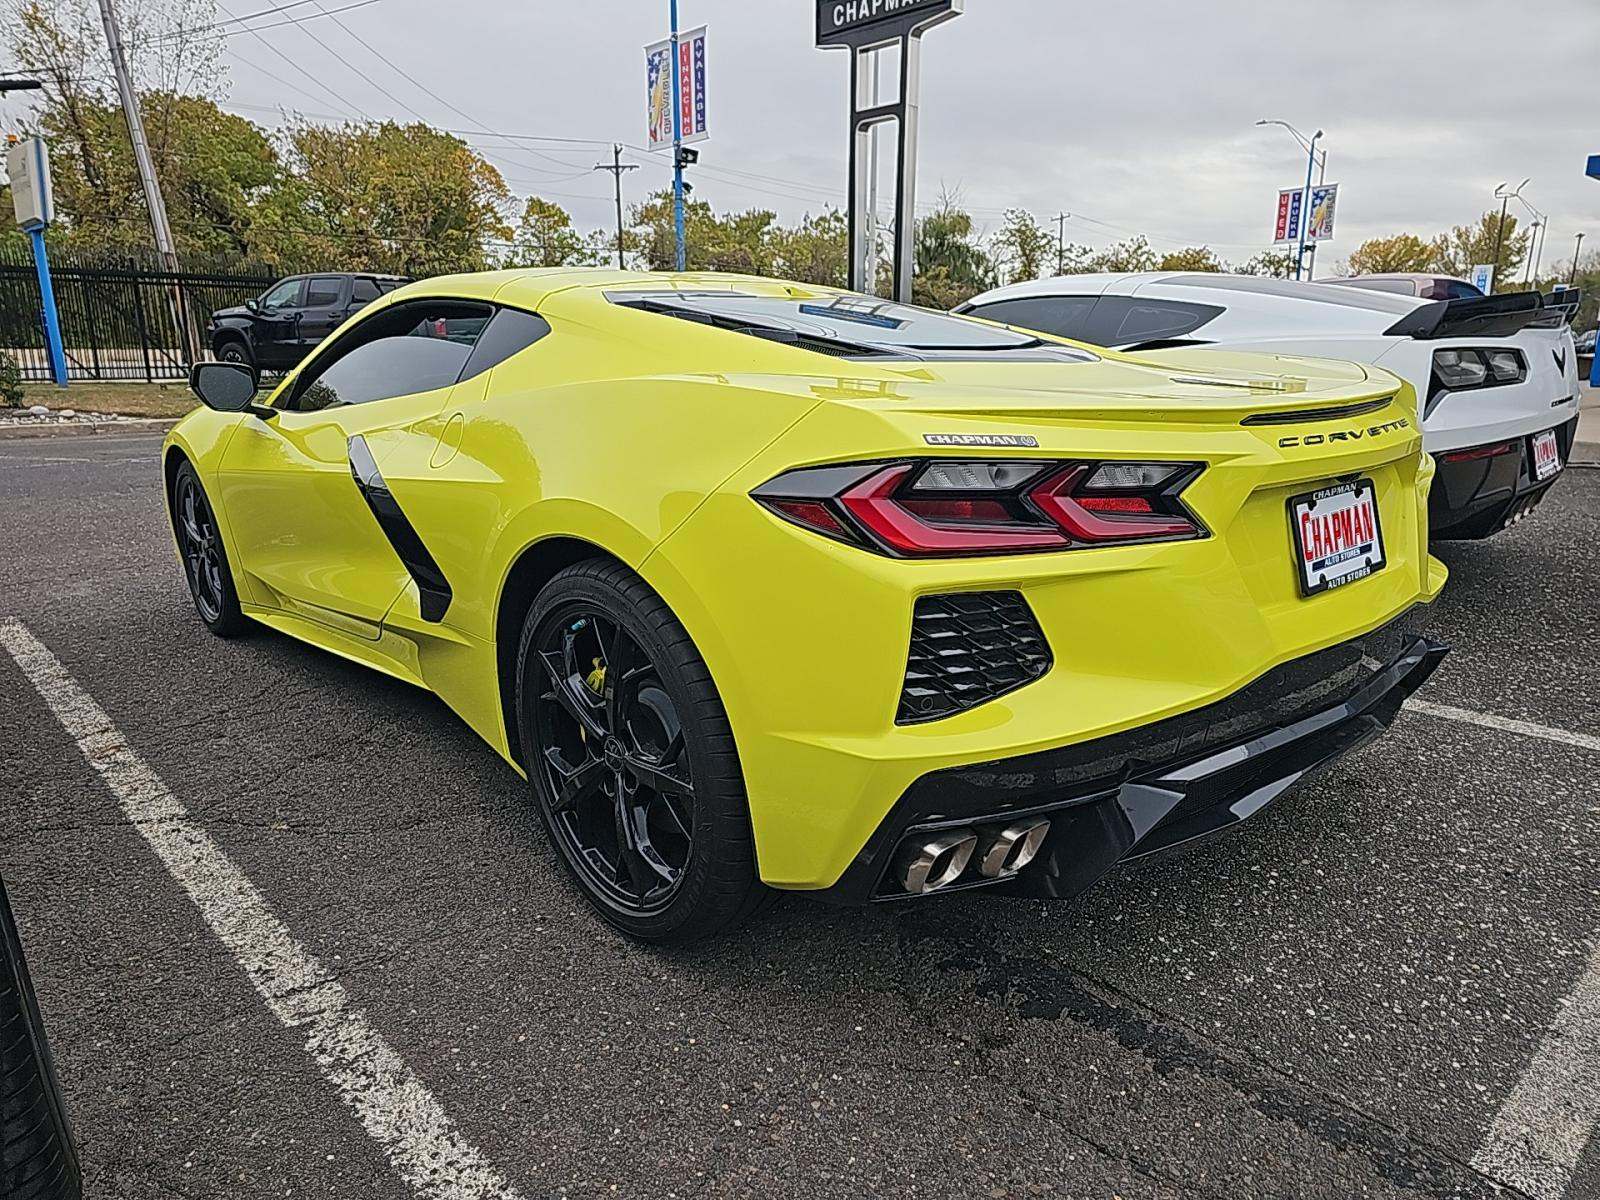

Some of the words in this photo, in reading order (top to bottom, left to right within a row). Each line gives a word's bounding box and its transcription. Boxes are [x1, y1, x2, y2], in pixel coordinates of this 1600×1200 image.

[833, 0, 927, 26] CHAPM
[681, 44, 691, 134] FINANCING
[695, 39, 705, 131] AVAILABLE
[1277, 195, 1288, 238] USED
[924, 434, 1018, 446] CHAPMAN
[1278, 418, 1409, 448] CORVETTE
[1312, 482, 1357, 501] CHAPMAN
[1301, 501, 1374, 562] CHAPMAN
[1324, 556, 1340, 567] AUTO
[1341, 548, 1361, 561] STORES
[1327, 576, 1346, 590] AUTO
[1347, 566, 1371, 581] STORES
